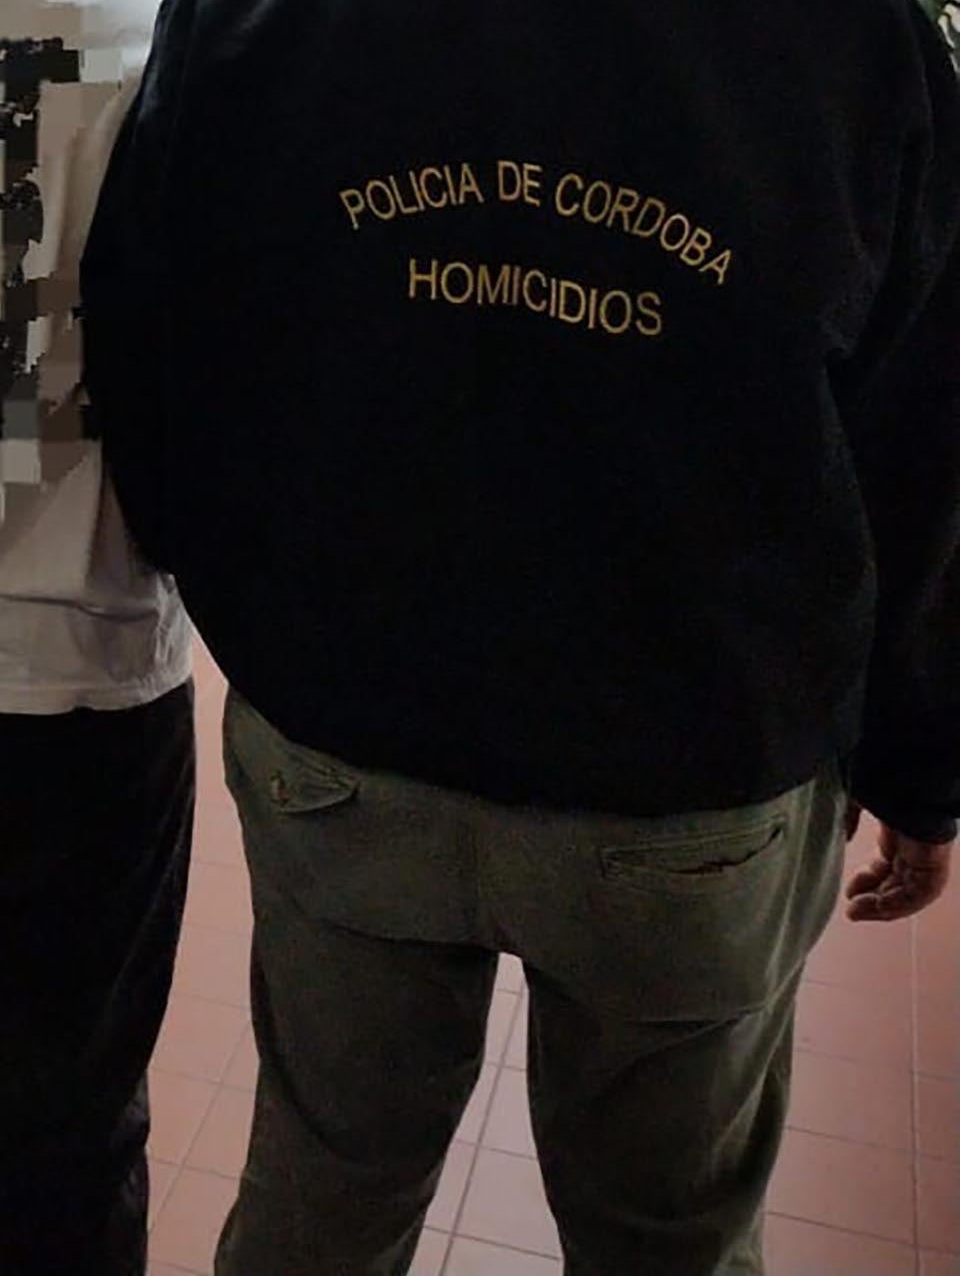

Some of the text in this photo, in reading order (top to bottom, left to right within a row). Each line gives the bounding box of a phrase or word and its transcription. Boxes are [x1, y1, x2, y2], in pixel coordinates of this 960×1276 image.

[340, 160, 734, 285] POLICIA DE CORDOBA
[408, 257, 663, 336] HOMICIDIOS
